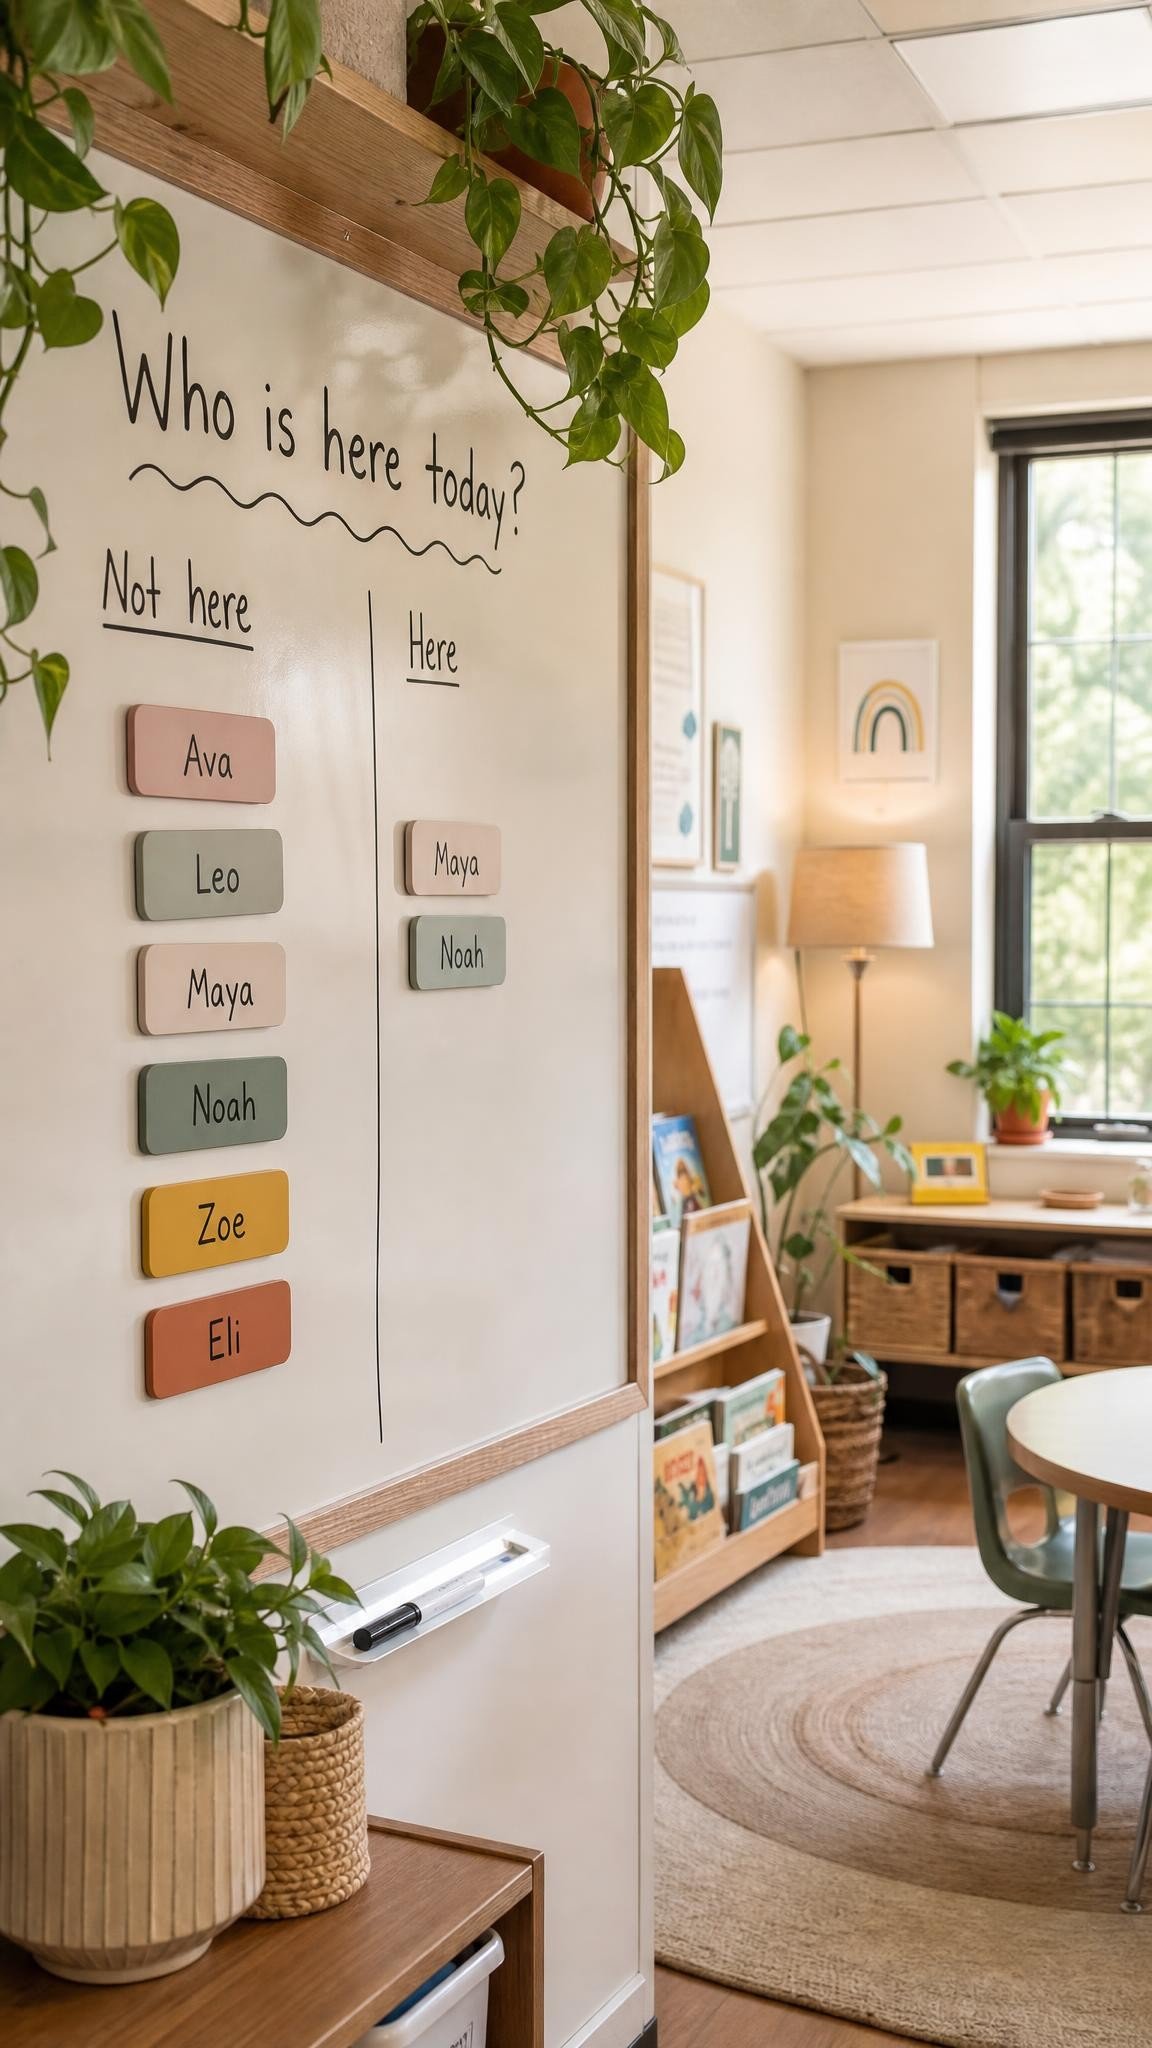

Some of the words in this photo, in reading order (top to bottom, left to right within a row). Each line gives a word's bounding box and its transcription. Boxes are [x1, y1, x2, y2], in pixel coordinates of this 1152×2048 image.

[111, 309, 235, 441] Who
[264, 383, 296, 458] is
[323, 385, 402, 491] here
[425, 432, 526, 550] today?
[102, 547, 161, 619] Not
[187, 558, 252, 634] here
[409, 610, 458, 674] Here
[183, 733, 233, 779] Ava
[196, 853, 240, 895] Leo
[434, 841, 480, 888] Maya
[441, 934, 484, 970] Noah
[187, 967, 254, 1022] Maya
[192, 1080, 256, 1127] Noah
[197, 1202, 246, 1246] Zoe
[209, 1316, 240, 1362] Eli
